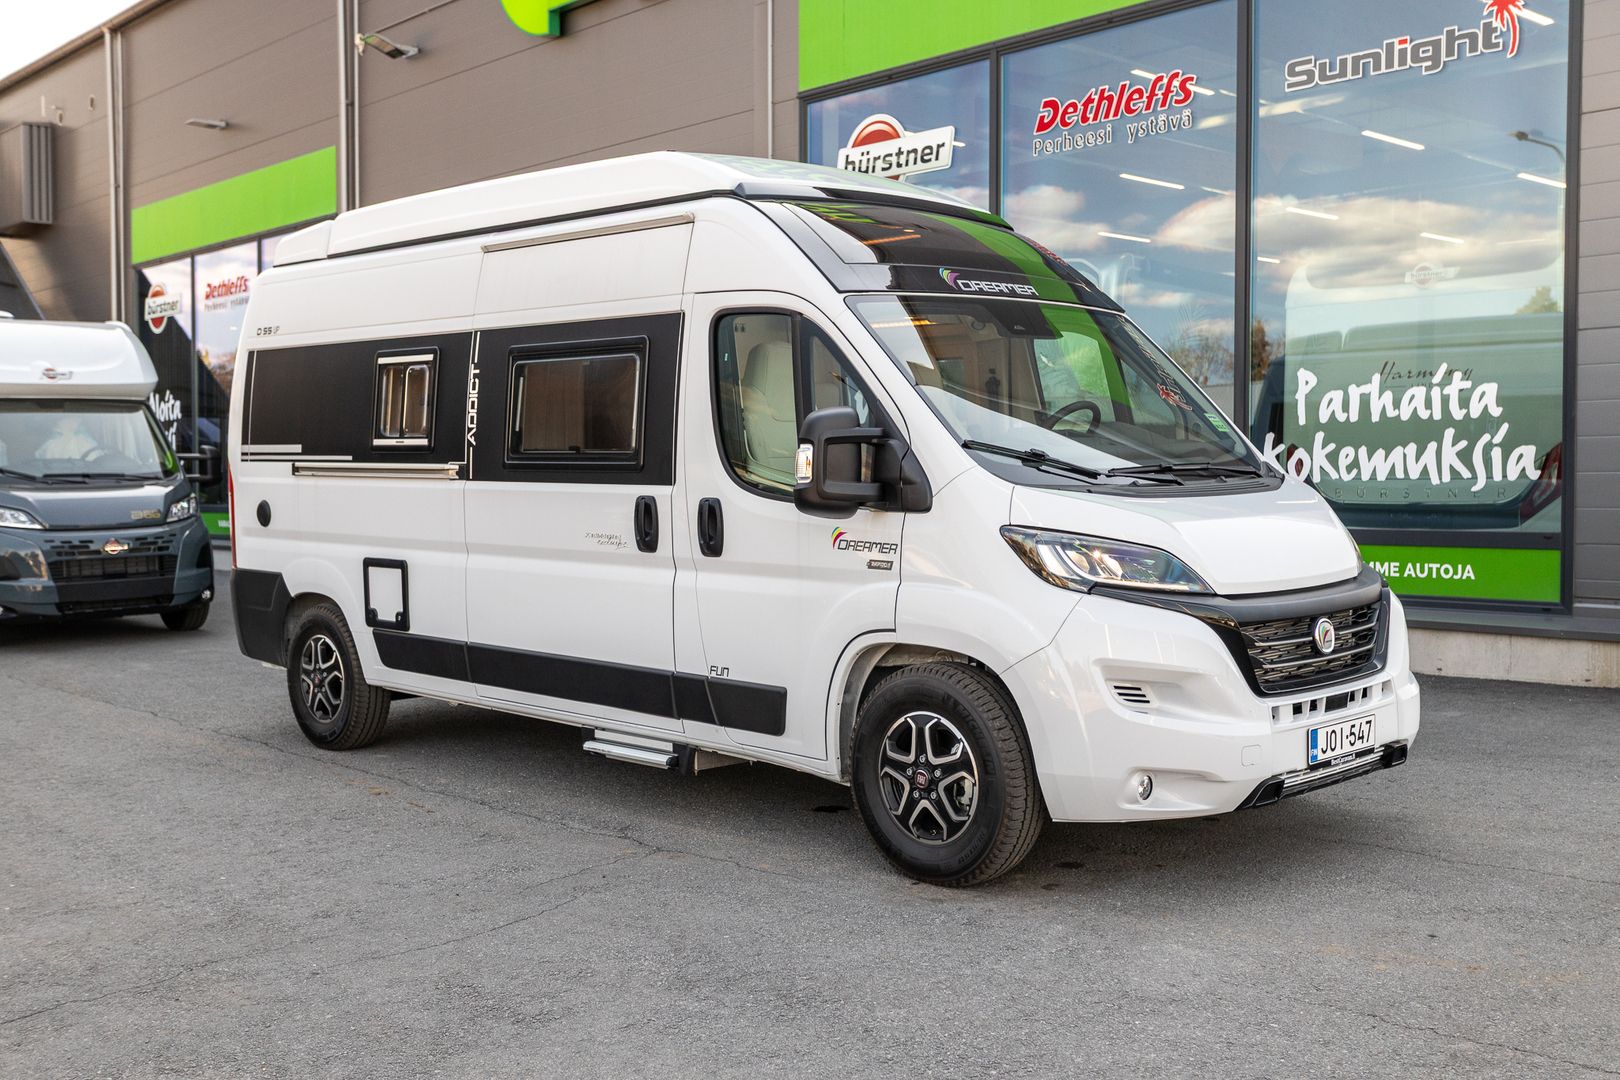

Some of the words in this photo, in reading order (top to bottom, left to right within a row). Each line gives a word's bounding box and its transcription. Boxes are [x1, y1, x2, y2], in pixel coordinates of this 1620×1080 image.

[1285, 18, 1503, 92] Sunlight
[1034, 70, 1197, 135] Dethleffs
[1032, 124, 1113, 156] Perheesi
[1127, 109, 1193, 144] ystävä
[844, 142, 946, 174] bürstner
[956, 279, 1040, 296] DREAMER
[467, 363, 480, 446] ADDICT
[1334, 486, 1507, 499] BÜRSTNER
[838, 539, 899, 555] DREAMER
[1403, 562, 1476, 580] AUTOJA
[709, 665, 730, 678] FUN
[1321, 720, 1372, 754] JOI-547
